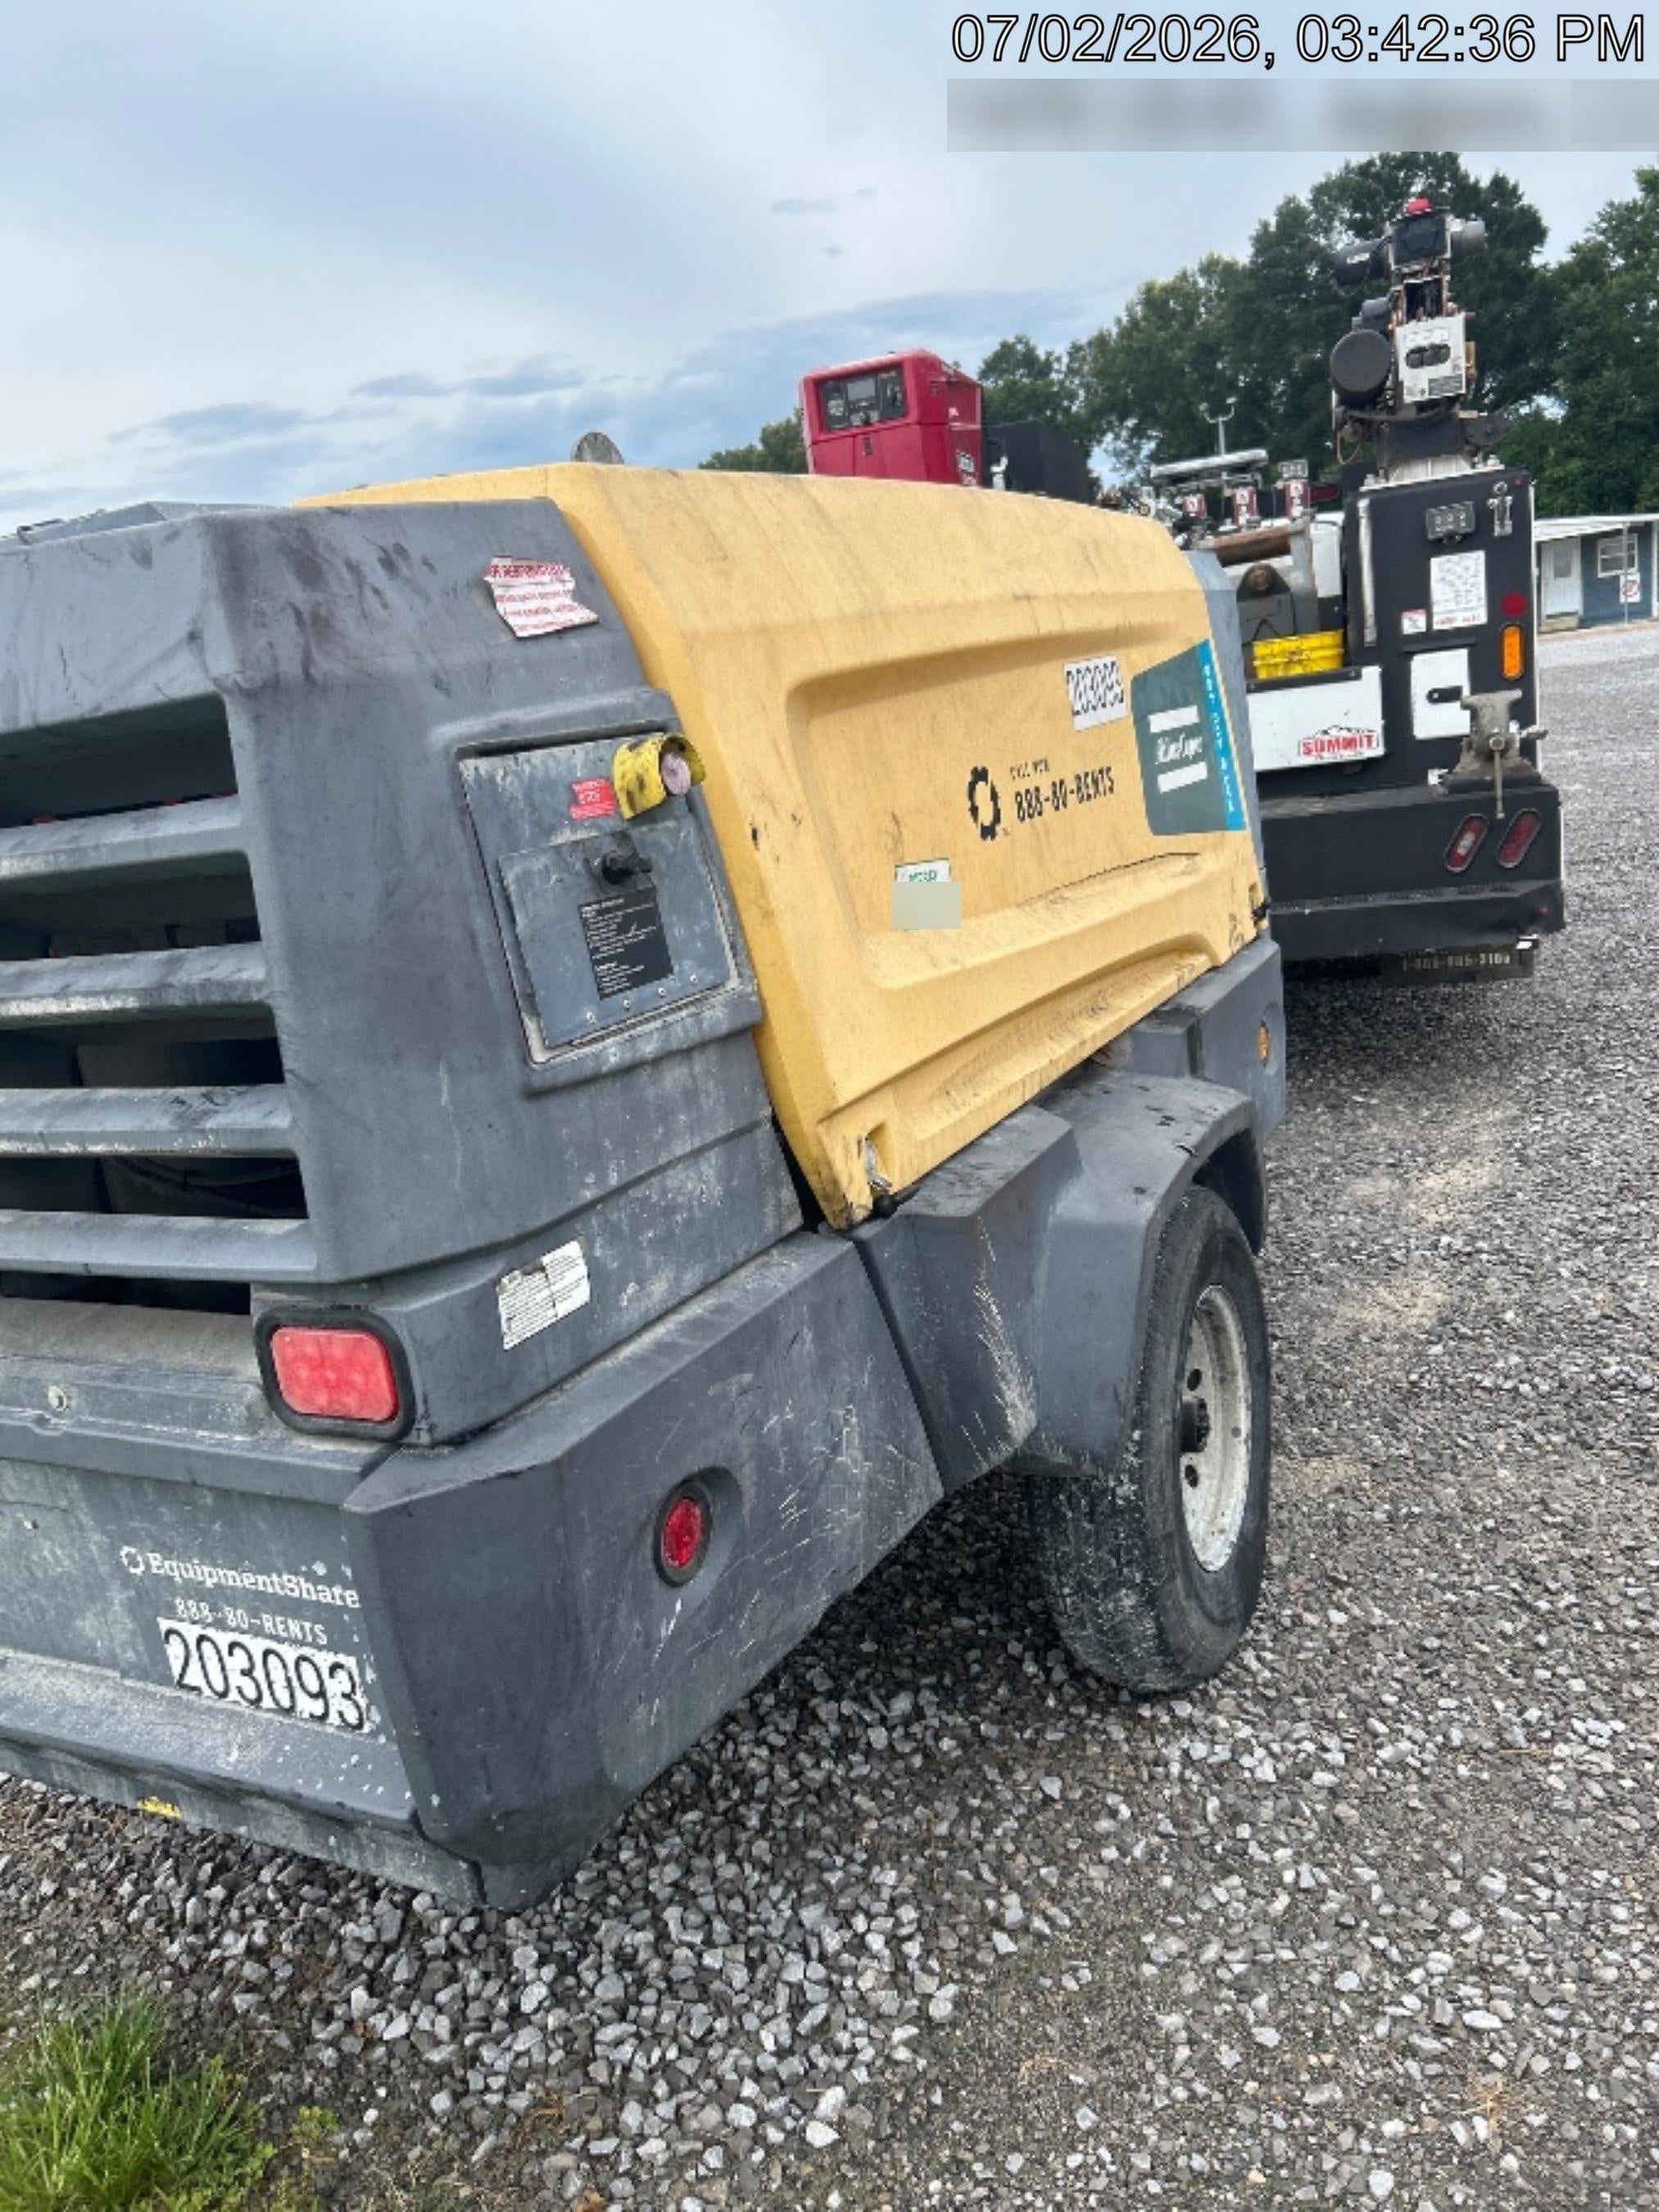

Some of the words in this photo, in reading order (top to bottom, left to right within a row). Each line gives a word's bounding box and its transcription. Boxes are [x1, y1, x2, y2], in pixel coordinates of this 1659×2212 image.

[1302, 734, 1375, 755] SUMMIT
[147, 1552, 360, 1608] EquipmentShare
[175, 1598, 327, 1645] 888-80-RENTS
[164, 1627, 364, 1731] 203093
